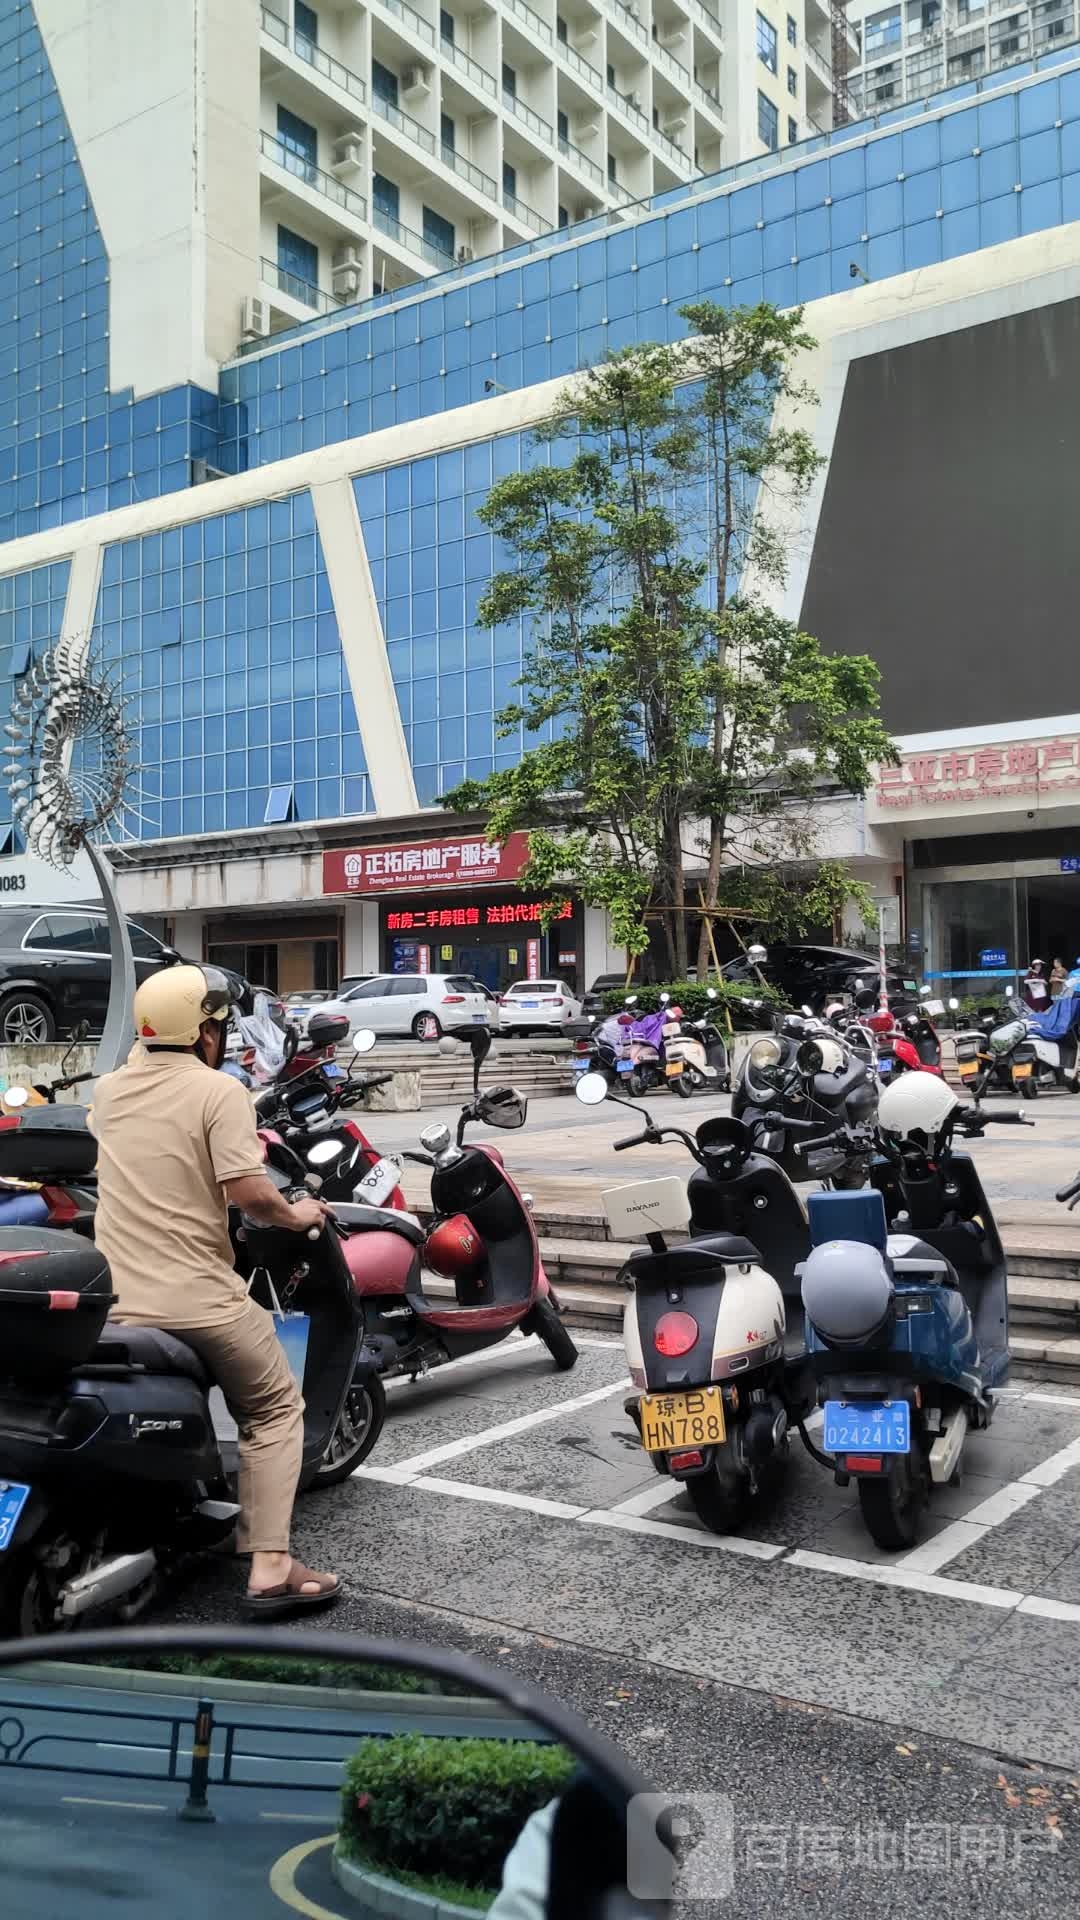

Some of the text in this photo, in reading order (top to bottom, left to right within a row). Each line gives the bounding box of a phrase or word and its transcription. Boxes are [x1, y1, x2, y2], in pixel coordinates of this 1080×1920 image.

[877, 738, 1080, 789] 三亚市房地产
[365, 843, 501, 875] 正拓房地产服务
[388, 901, 573, 930] 新房二手房租售 法拍代拍资
[646, 1415, 720, 1449] HN788
[827, 1426, 906, 1446] 0242413
